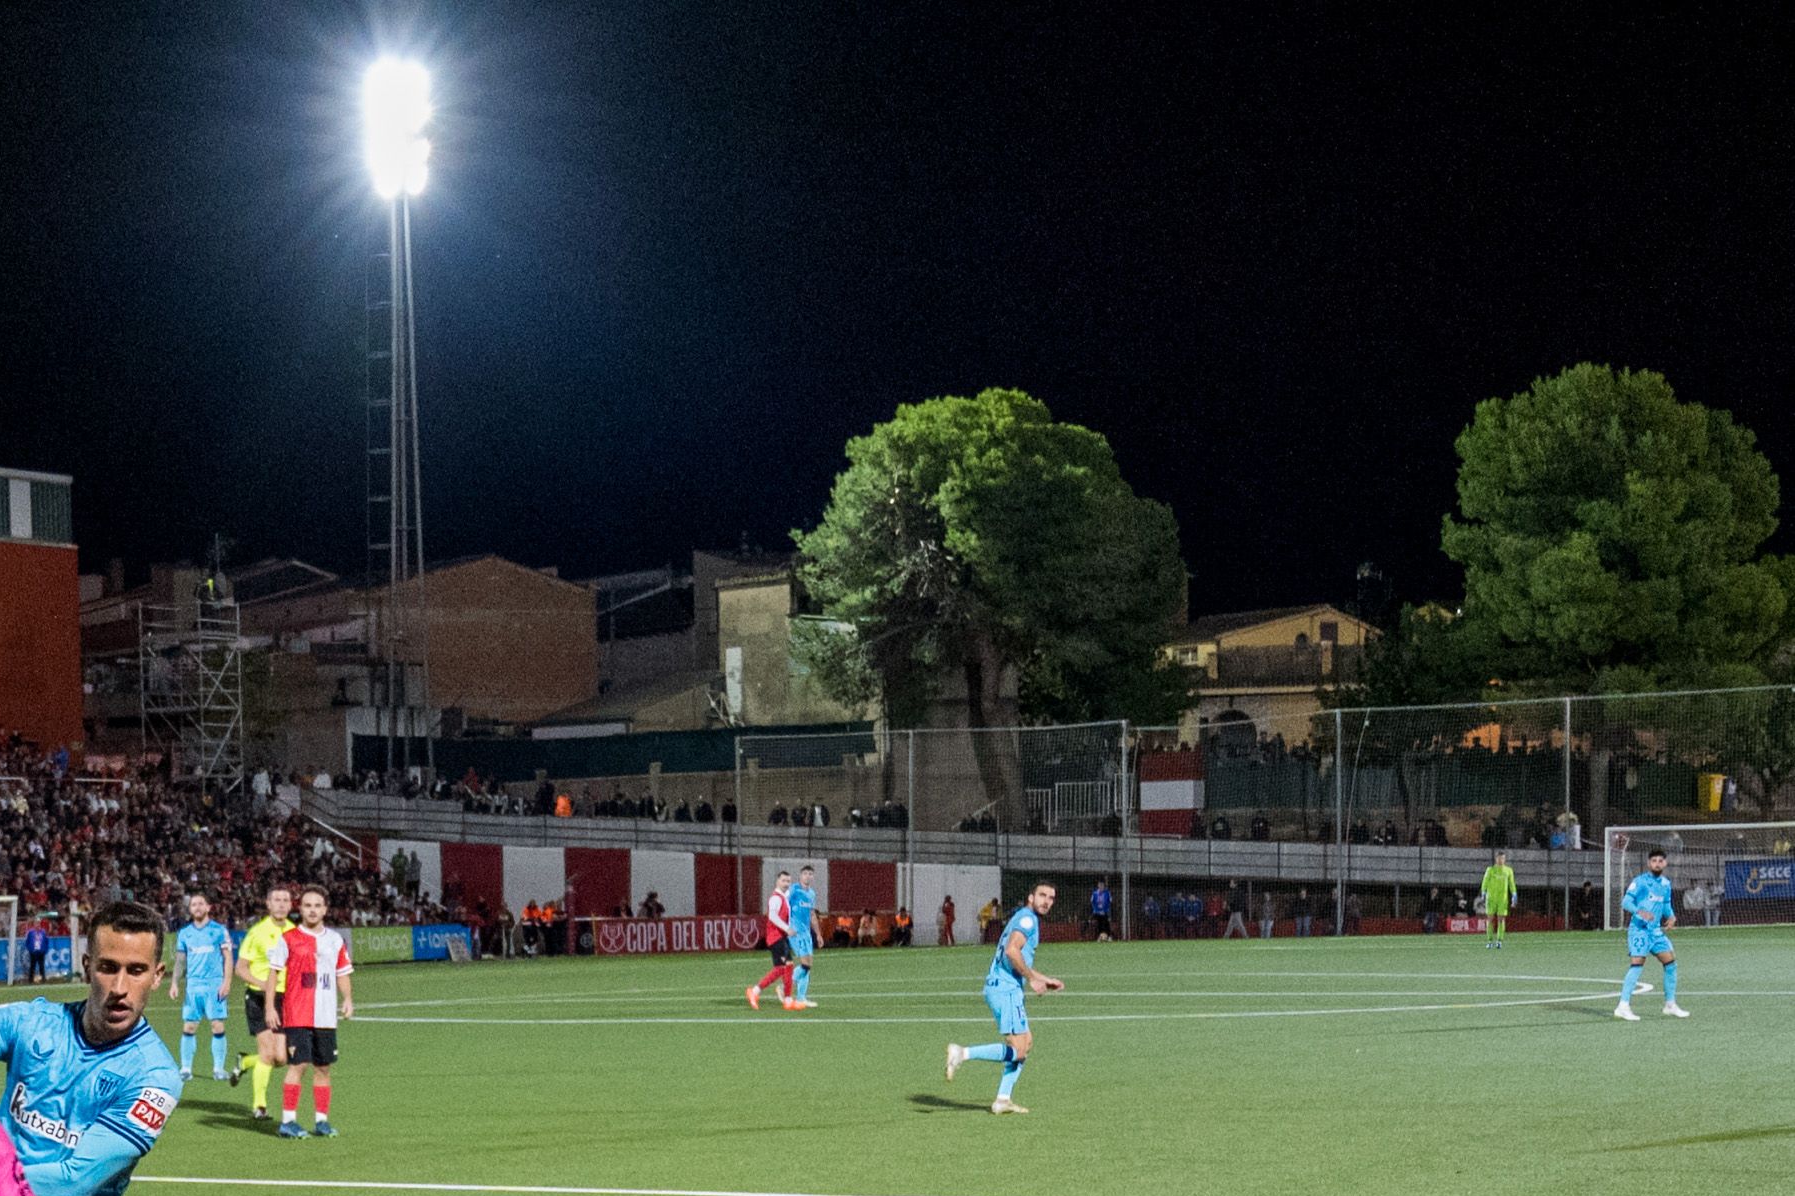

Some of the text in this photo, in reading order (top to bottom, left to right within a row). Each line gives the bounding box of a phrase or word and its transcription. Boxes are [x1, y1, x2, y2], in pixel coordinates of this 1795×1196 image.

[626, 918, 732, 953] COPA DEL REY
[143, 1089, 166, 1108] B2B
